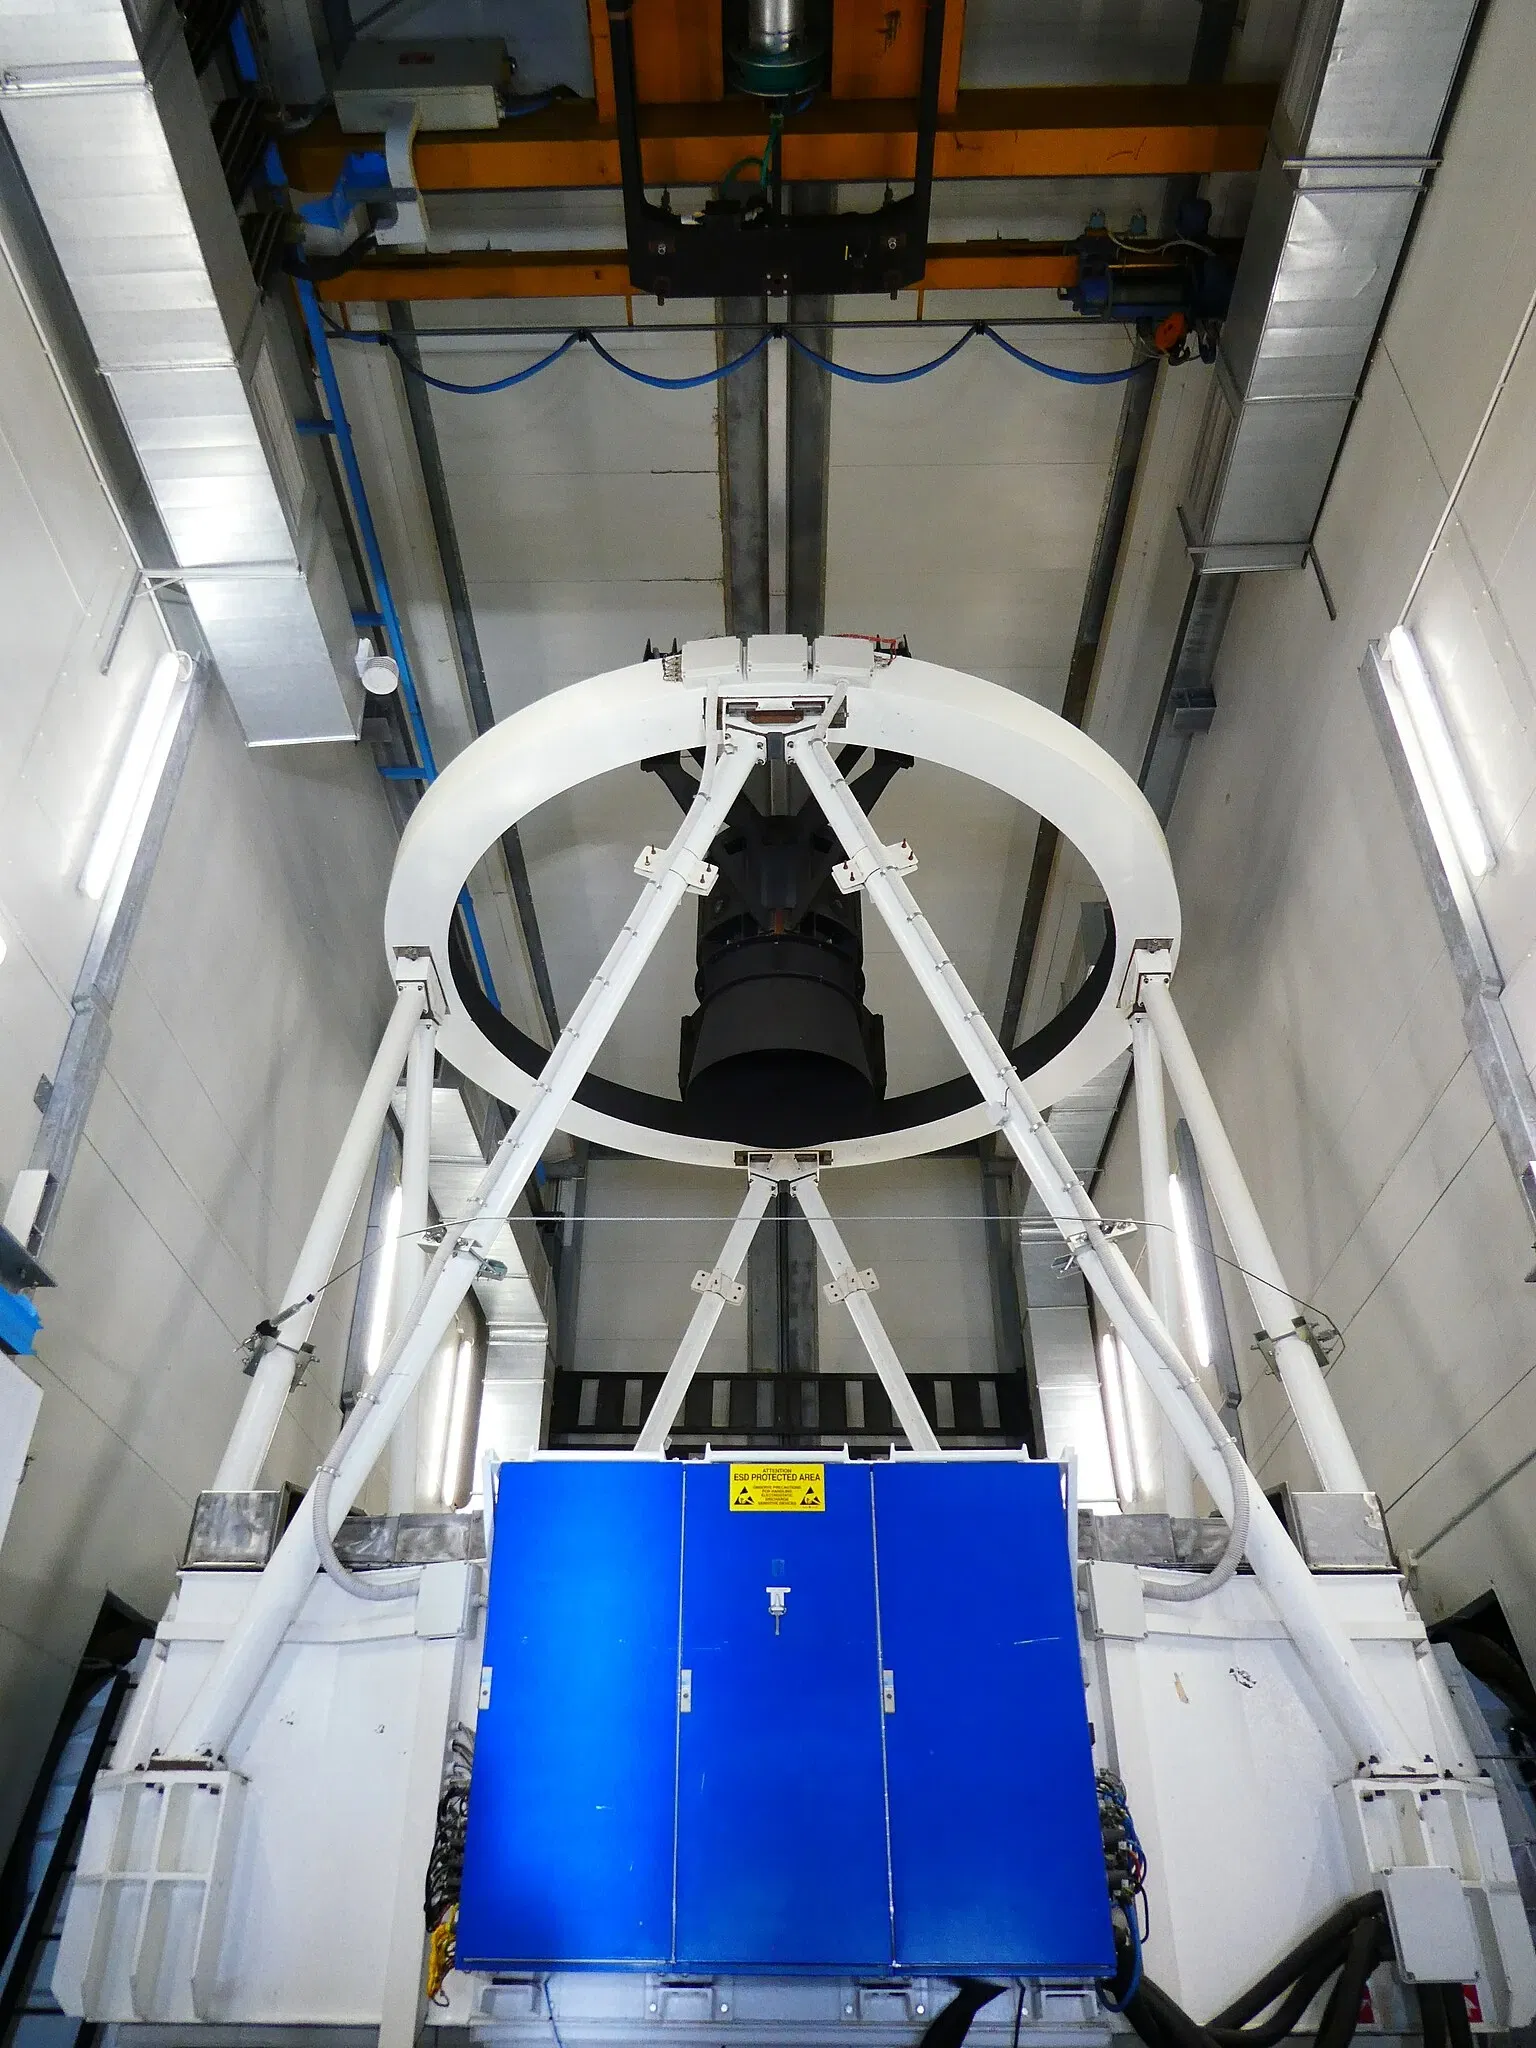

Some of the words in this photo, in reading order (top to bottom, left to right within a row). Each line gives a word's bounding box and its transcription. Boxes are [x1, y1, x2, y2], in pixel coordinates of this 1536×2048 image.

[734, 1473, 750, 1481] ESD
[751, 1473, 797, 1481] PROTECTED
[799, 1473, 821, 1481] AREA
